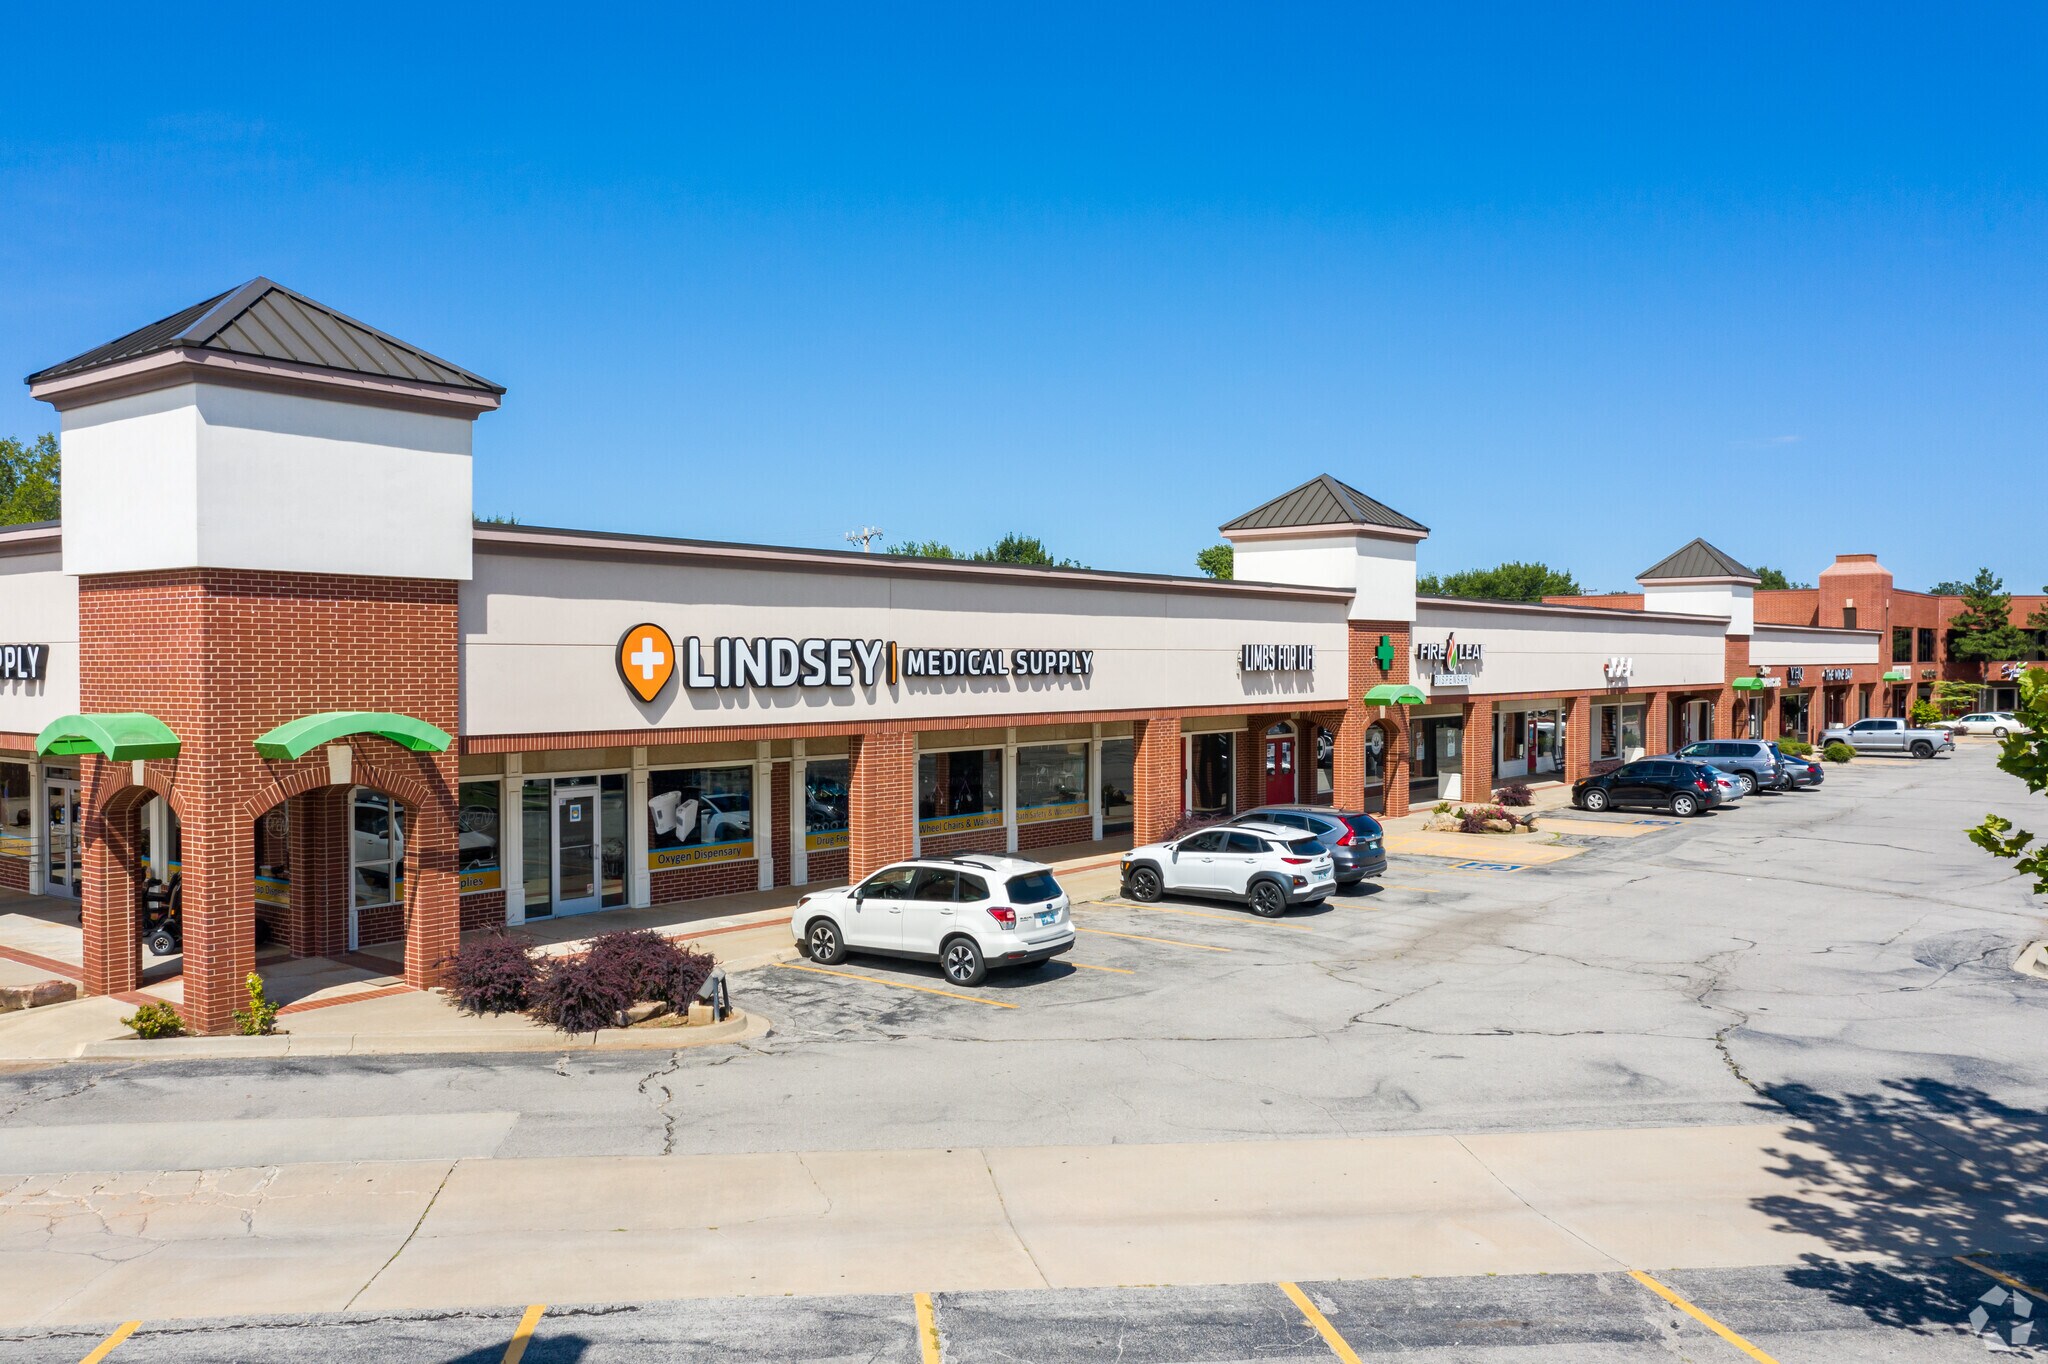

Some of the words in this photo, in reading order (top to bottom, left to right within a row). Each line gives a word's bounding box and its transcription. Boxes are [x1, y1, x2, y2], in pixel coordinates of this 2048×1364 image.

[1245, 644, 1275, 671] LIMBS
[1278, 644, 1297, 671] FOR
[1299, 644, 1316, 671] LIFE
[1420, 643, 1446, 660] FIRE
[1459, 643, 1486, 660] LEAF
[0, 646, 40, 678] PLY
[687, 636, 883, 688] LINDSEY
[906, 650, 1009, 675] MEDICAL
[1015, 650, 1094, 675] SUPPLY
[919, 821, 942, 834] Wheel
[943, 819, 964, 831] Chairs
[966, 818, 972, 827] &
[973, 815, 1000, 827] Walkers
[816, 836, 835, 846] Drug
[836, 834, 849, 843] Fre
[657, 850, 692, 865] Oxygen
[694, 846, 742, 862] Dispensary
